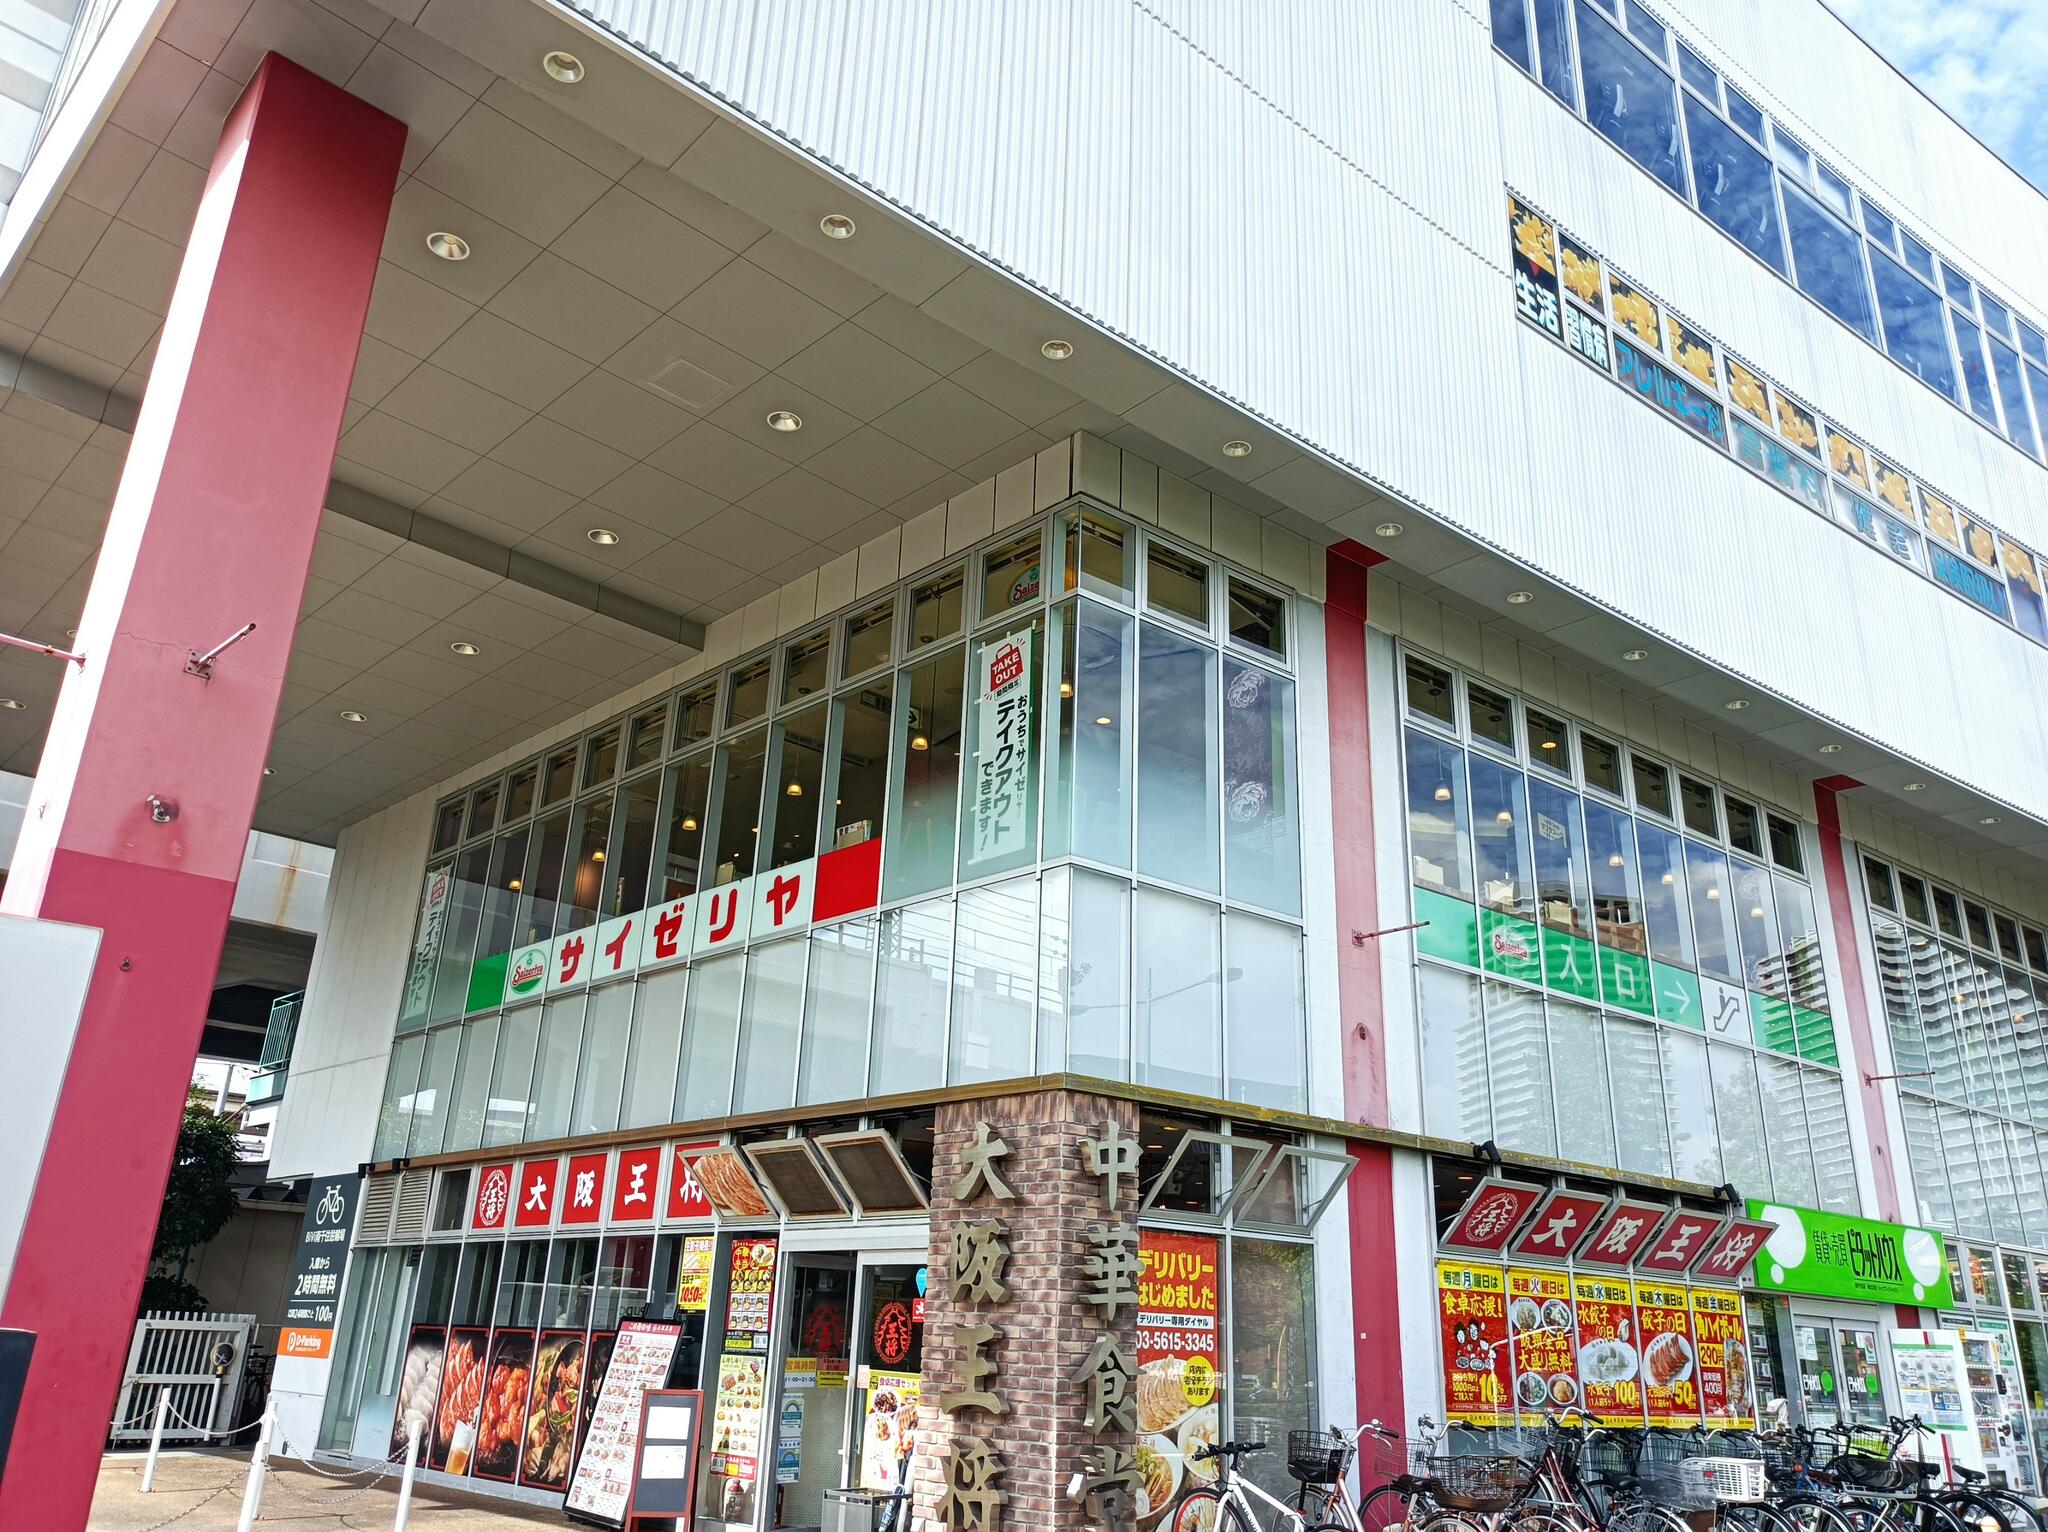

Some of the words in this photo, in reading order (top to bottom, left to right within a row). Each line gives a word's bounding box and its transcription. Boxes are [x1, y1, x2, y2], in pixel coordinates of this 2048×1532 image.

[992, 651, 1020, 675] TAKE
[995, 664, 1018, 685] OUT
[994, 699, 1015, 844] テイクアウト
[979, 761, 994, 852] できます!
[560, 874, 801, 984] サイゼリヤ
[1559, 944, 1636, 1000] 入口
[1531, 1208, 1755, 1271] 大阪王将
[1138, 1249, 1214, 1281] デリバリー
[294, 1273, 337, 1297] 2時間無料
[1443, 1269, 1499, 1289] 毎週月曜日は
[1512, 1275, 1565, 1296] 毎週火曜日は
[1137, 1282, 1215, 1310] はじめました
[1576, 1283, 1627, 1301] 毎週水曜日は
[1639, 1289, 1684, 1307] 毎週木曜日は
[1695, 1294, 1737, 1312] 毎週金曜日は
[314, 1305, 333, 1323] 100円
[1443, 1291, 1503, 1318] 食卓応援!
[1578, 1305, 1610, 1326] 水餃子
[1641, 1310, 1687, 1333] 餃子の日
[1694, 1313, 1742, 1341] 角ハイボール
[295, 1333, 322, 1350] D-Parking
[1189, 1365, 1207, 1375] 店内に
[1518, 1349, 1573, 1373] 大盛り無料
[1186, 1387, 1210, 1396] あります
